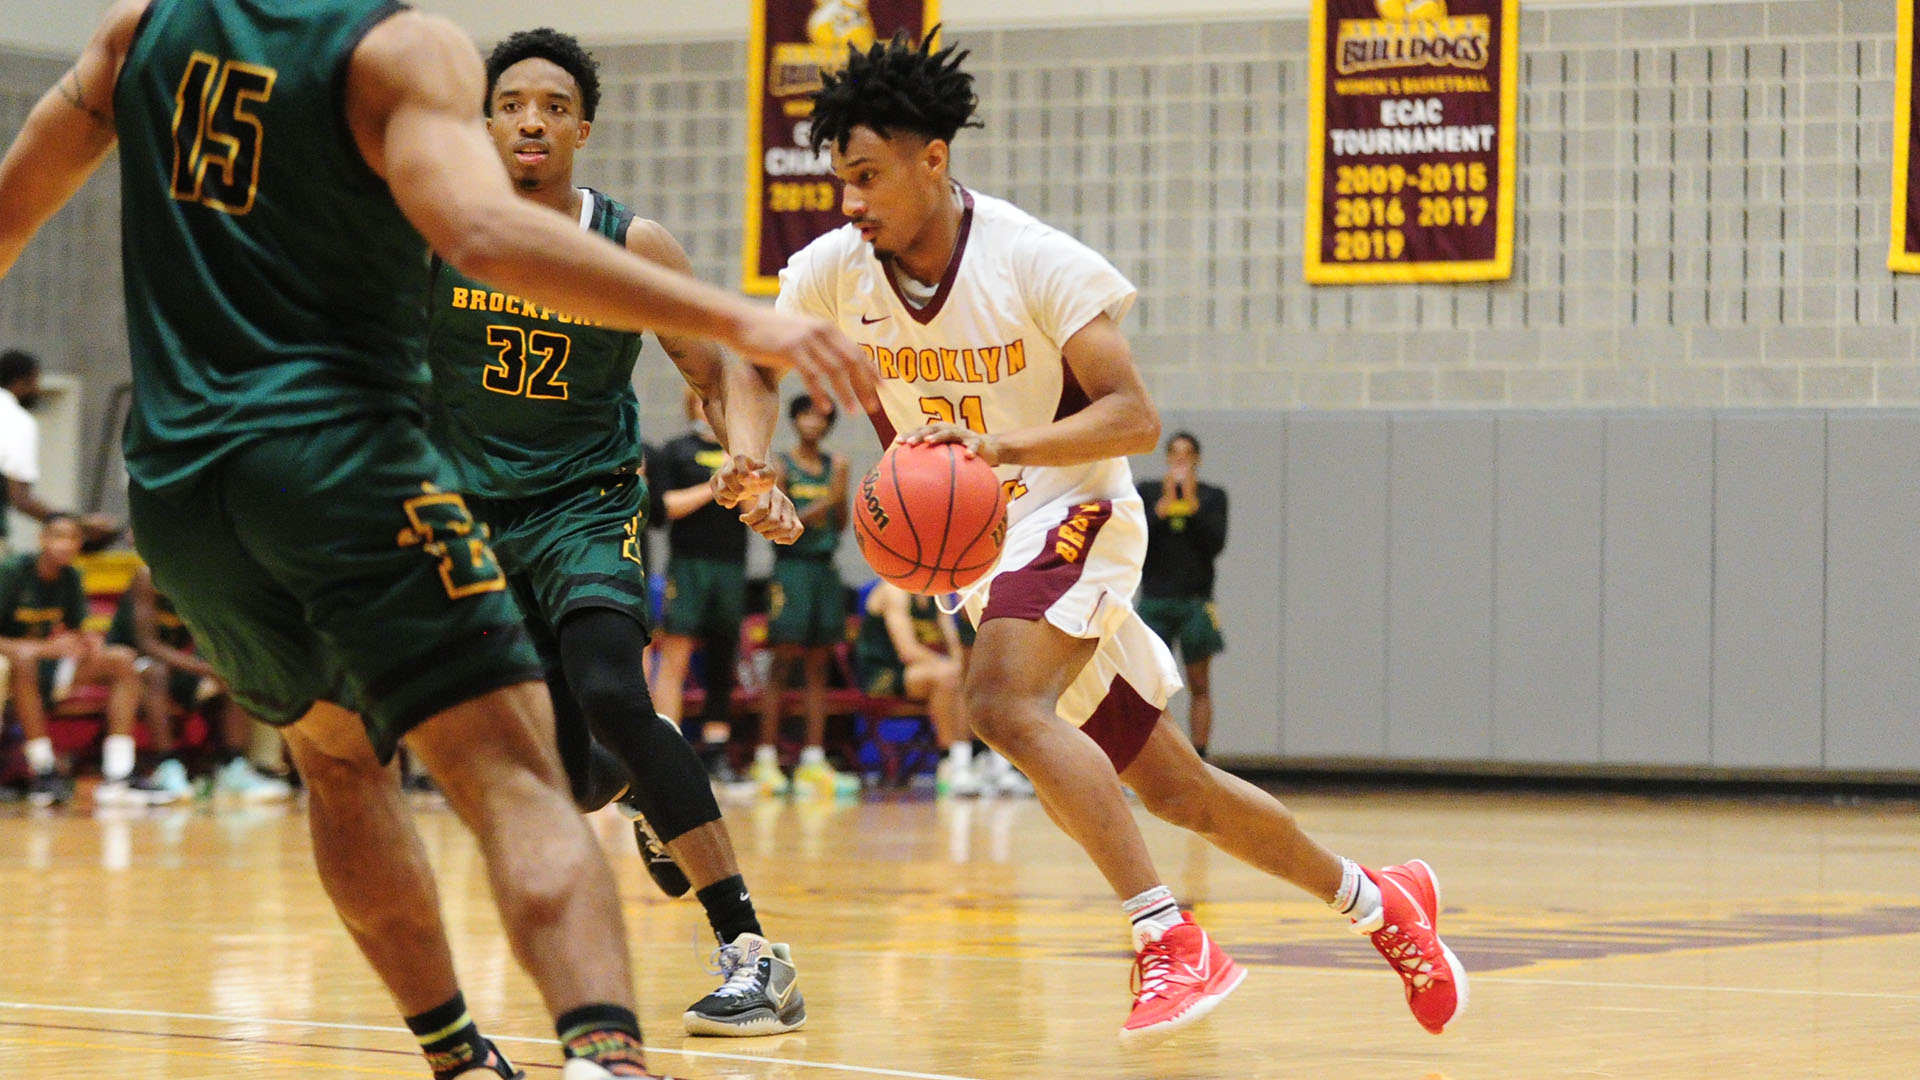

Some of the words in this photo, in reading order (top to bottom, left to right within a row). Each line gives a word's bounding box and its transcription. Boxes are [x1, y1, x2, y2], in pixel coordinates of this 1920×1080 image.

[1342, 36, 1484, 66] BULLDOGS
[1380, 98, 1443, 126] ECAC
[170, 50, 278, 216] 15
[1330, 124, 1495, 155] TOURNAMENT
[1336, 162, 1488, 194] 2009-2015
[1334, 197, 1405, 228] 2016
[1417, 195, 1488, 227] 2017
[1334, 229, 1405, 260] 2019
[452, 286, 603, 327] BROCKP
[482, 324, 571, 400] 32
